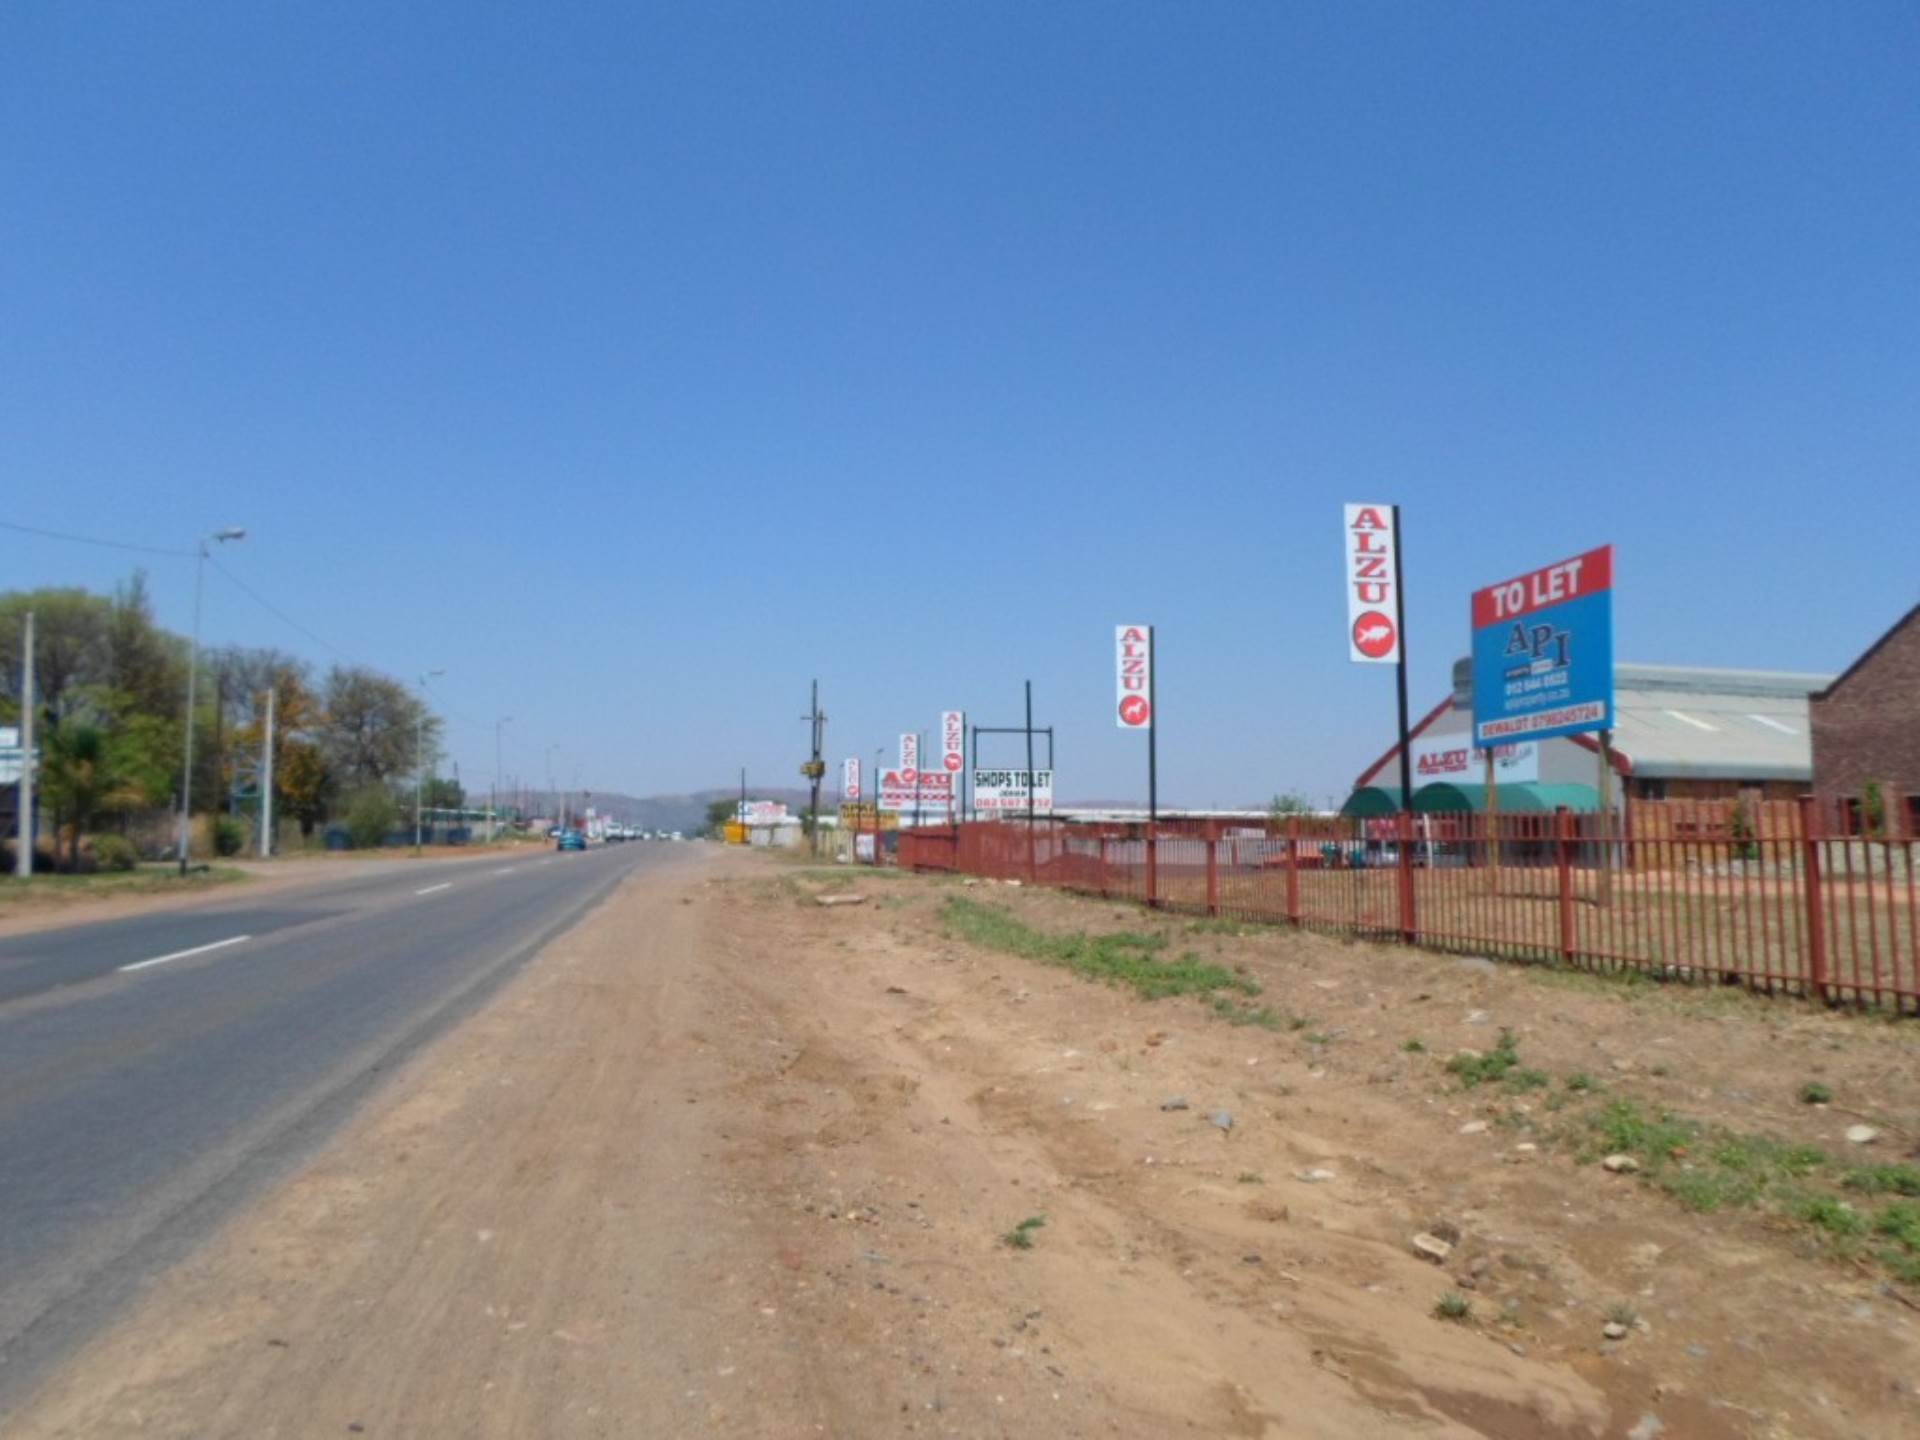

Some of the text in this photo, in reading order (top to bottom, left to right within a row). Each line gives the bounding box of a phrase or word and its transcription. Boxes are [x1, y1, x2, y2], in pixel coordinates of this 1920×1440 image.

[1350, 507, 1389, 604] ALZU
[1492, 558, 1582, 617] TO LET
[1120, 627, 1146, 691] ALZU
[1504, 621, 1571, 667] API
[946, 713, 959, 750] ALZU
[976, 771, 1012, 788] SHOPS
[1014, 771, 1029, 788] TO
[1418, 749, 1468, 769] ALZU
